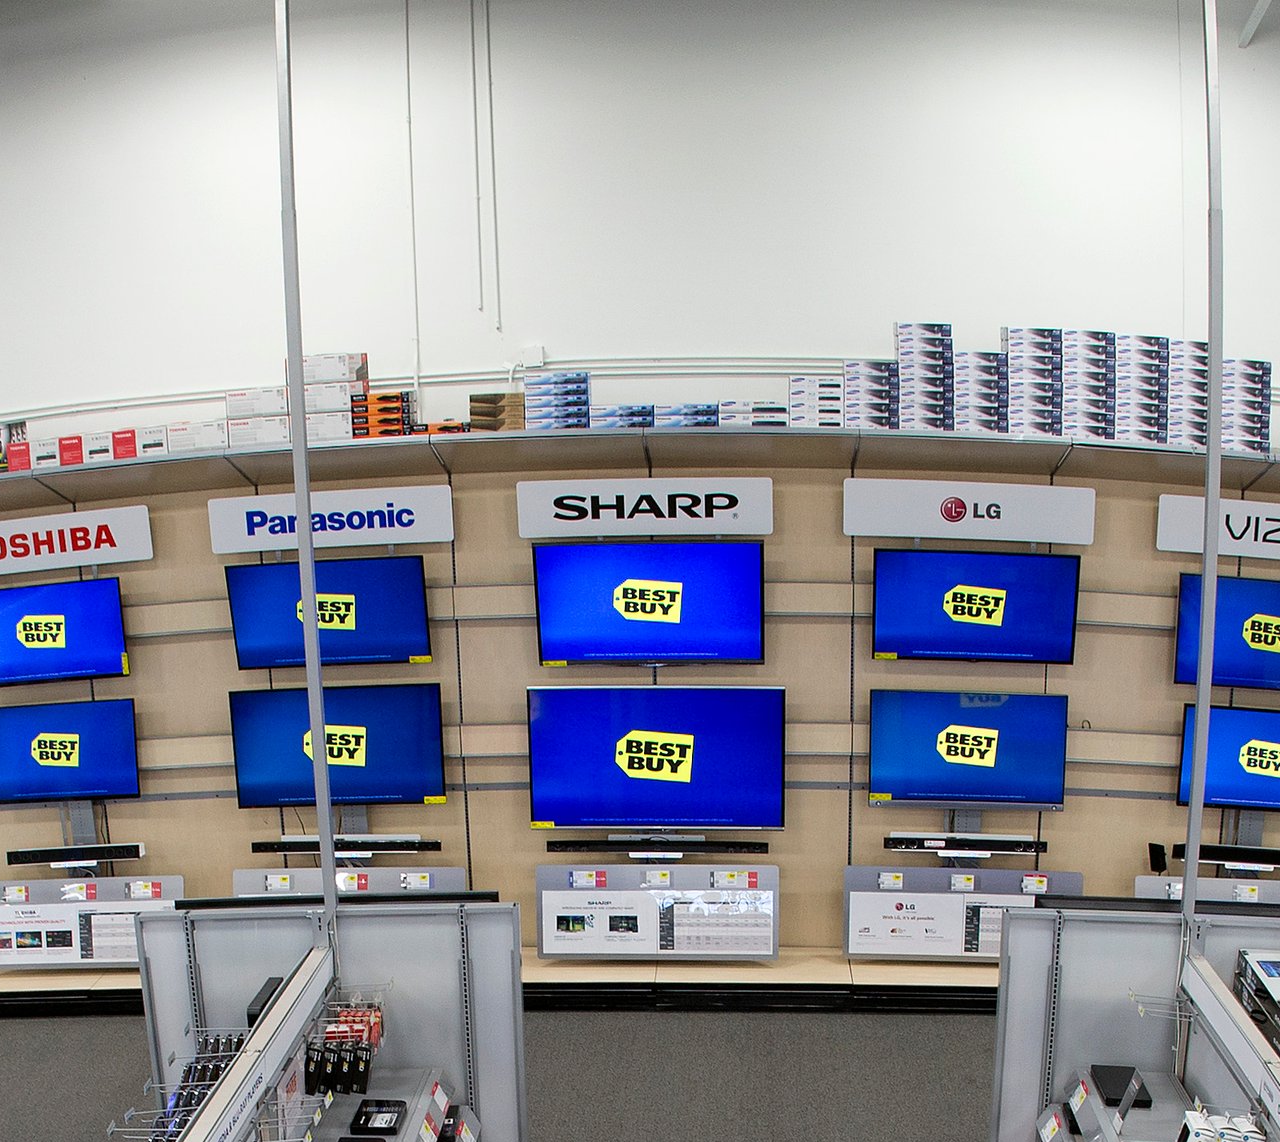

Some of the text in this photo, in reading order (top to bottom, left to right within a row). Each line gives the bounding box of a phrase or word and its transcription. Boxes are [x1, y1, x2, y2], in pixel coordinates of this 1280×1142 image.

[552, 492, 739, 520] SHARP
[972, 502, 1002, 520] LG
[246, 503, 415, 537] Panasonic
[621, 588, 680, 603] BEST
[951, 591, 1004, 607] BEST
[317, 601, 354, 613] EST
[623, 601, 675, 616] BUY
[951, 604, 999, 619] BUY
[22, 622, 63, 634] BEST
[24, 631, 60, 644] BUY
[37, 739, 79, 752] BEST
[326, 733, 365, 746] EST
[945, 731, 997, 747] BEST
[39, 750, 73, 761] BUY
[327, 745, 360, 760] UY
[625, 740, 692, 758] BEST
[945, 744, 991, 760] BUY
[627, 756, 687, 774] BUY
[233, 1098, 249, 1126] BLU-RAY
[247, 1073, 264, 1099] PLAYERS
